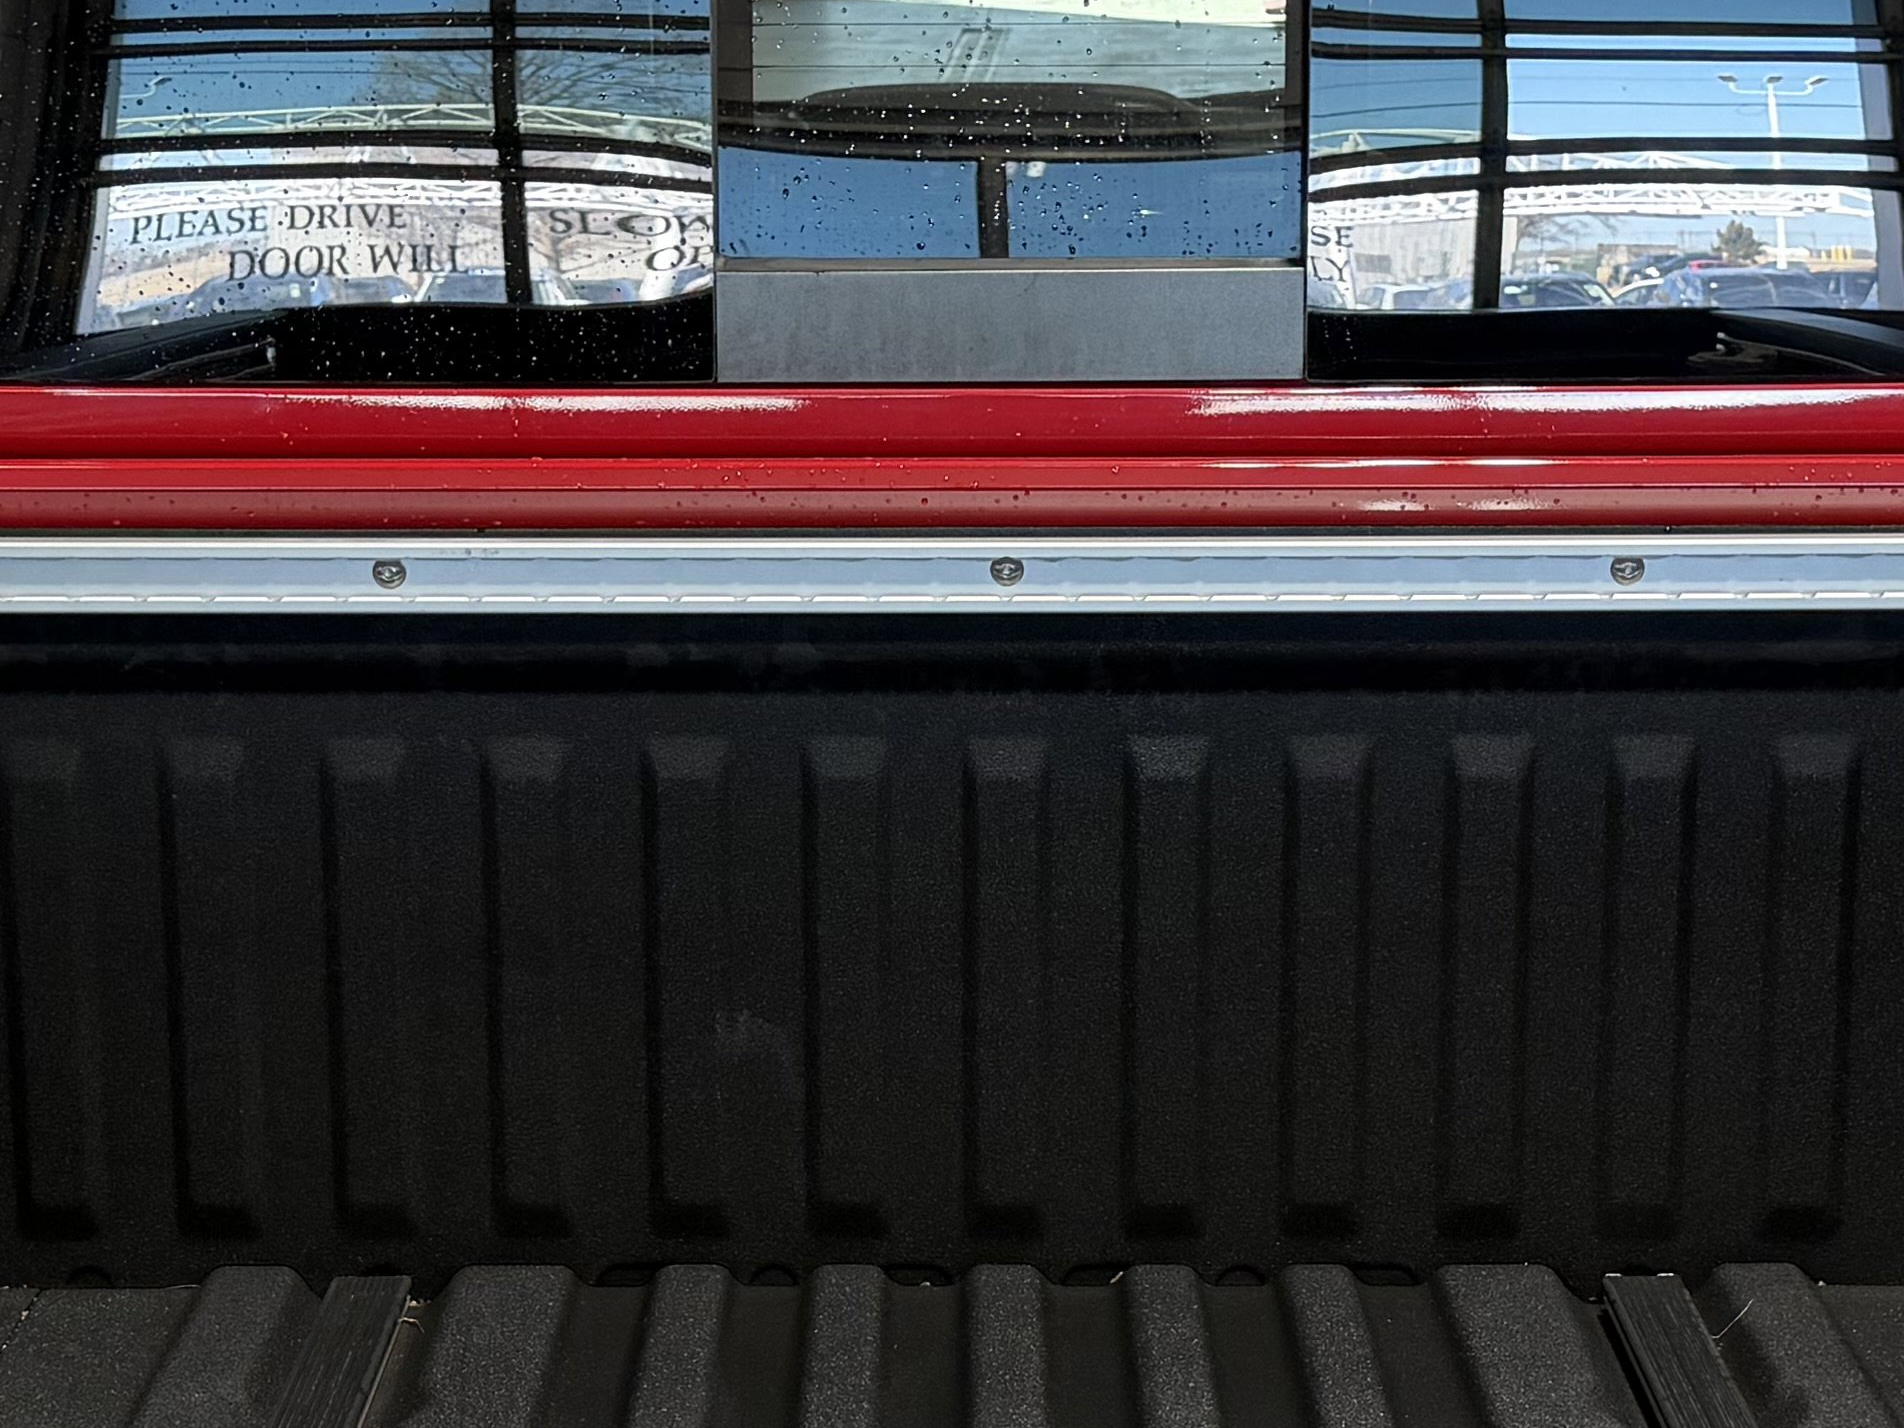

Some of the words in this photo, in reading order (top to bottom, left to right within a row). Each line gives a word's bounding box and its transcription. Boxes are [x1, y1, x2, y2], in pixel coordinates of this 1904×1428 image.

[131, 206, 268, 245] PLEASE
[287, 204, 406, 231] DRIVE
[227, 244, 351, 282] DOOR
[368, 242, 476, 275] WILL
